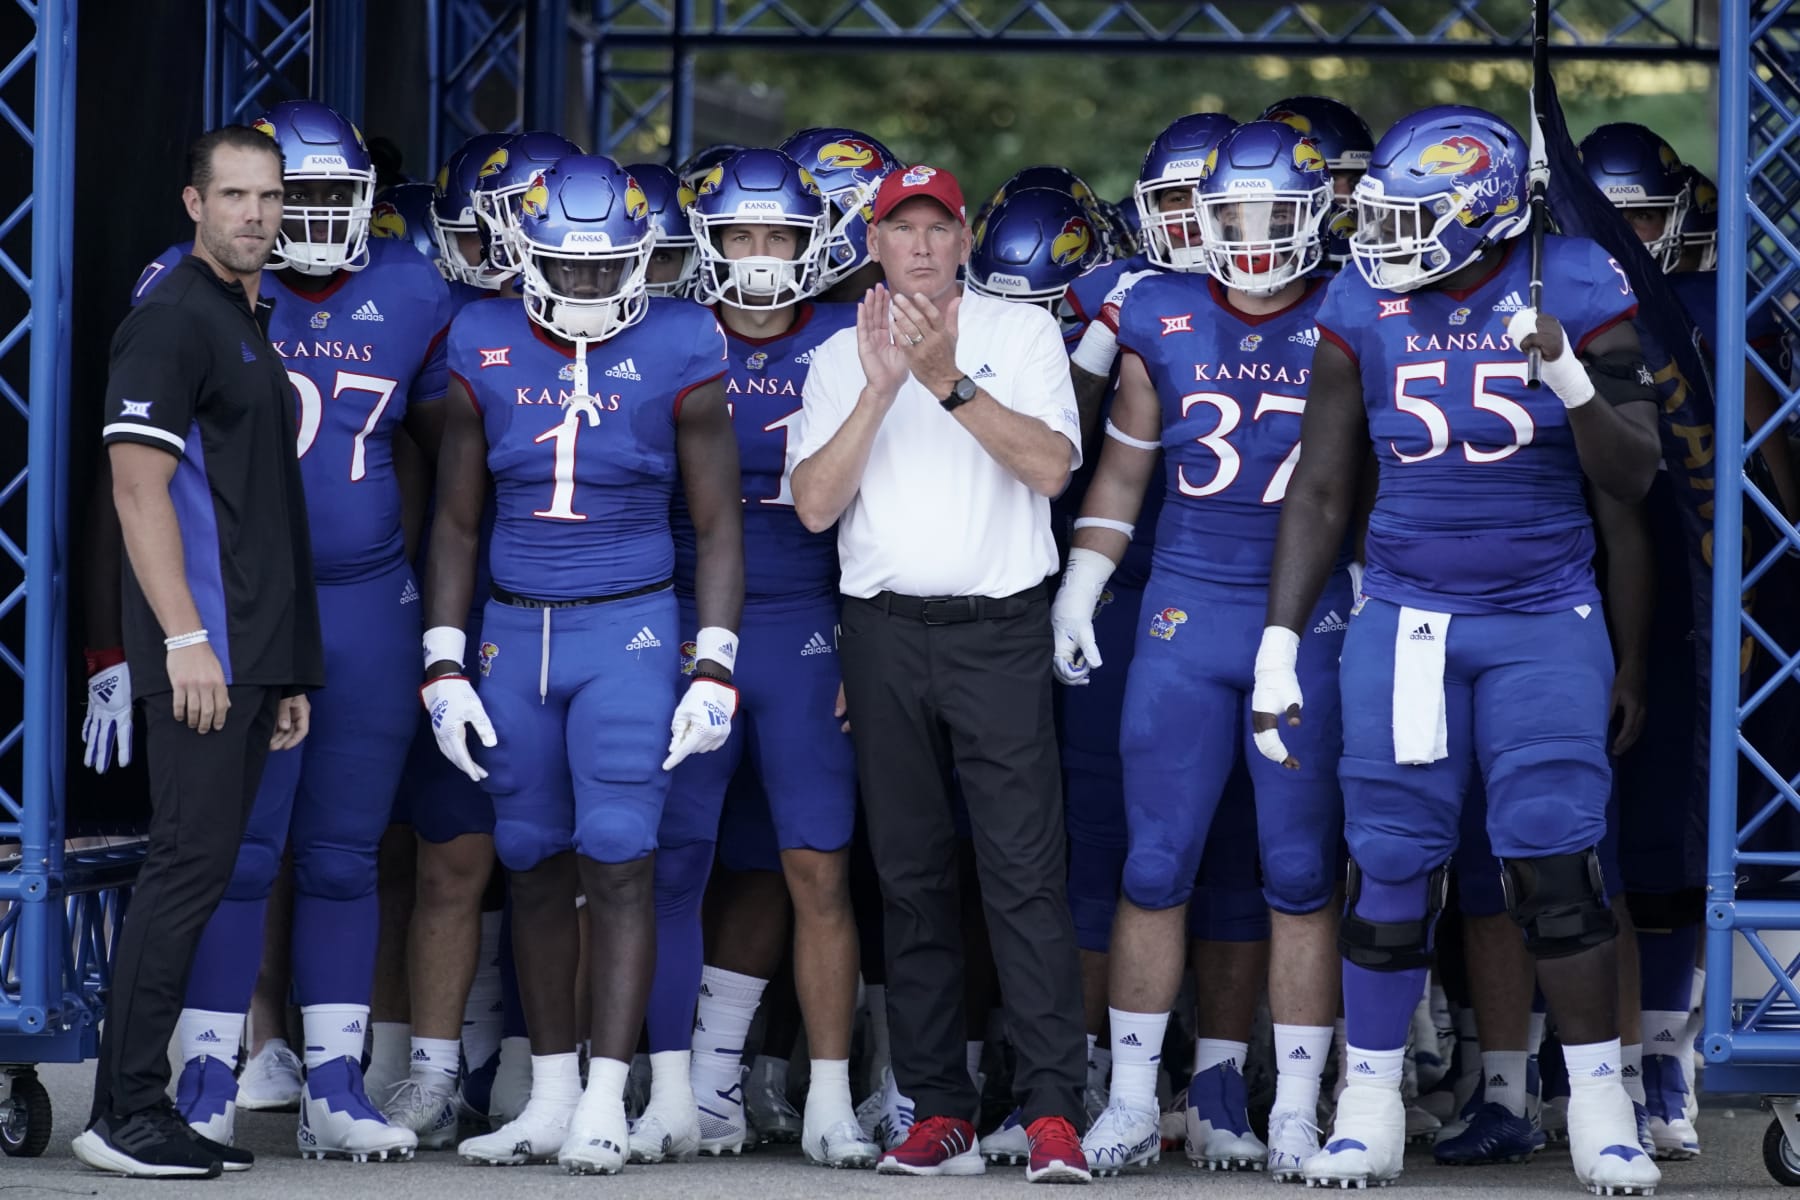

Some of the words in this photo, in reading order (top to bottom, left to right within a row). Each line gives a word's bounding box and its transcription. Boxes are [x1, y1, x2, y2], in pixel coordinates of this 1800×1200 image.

[311, 156, 343, 165] KANSAS
[1169, 160, 1200, 170] KANSAS
[1235, 181, 1266, 189] KANSAS
[1476, 178, 1499, 197] KU
[1609, 186, 1640, 194] KANSAS
[744, 202, 777, 210] KANSAS
[571, 234, 603, 242] KANSAS
[992, 276, 1022, 287] KANSAS
[1492, 305, 1528, 313] adida
[352, 313, 384, 322] adidas
[1405, 332, 1513, 352] KANSAS
[272, 341, 373, 361] KANSAS
[604, 369, 642, 381] adidas
[1194, 363, 1310, 385] KANSAS
[726, 377, 804, 397] ANSA
[516, 387, 621, 411] KANAS
[1390, 359, 1535, 464] 55
[1178, 392, 1307, 504] 37
[533, 415, 588, 521] 1
[1409, 633, 1435, 641] adidas
[626, 639, 661, 651] adidas
[800, 645, 832, 656] adidas
